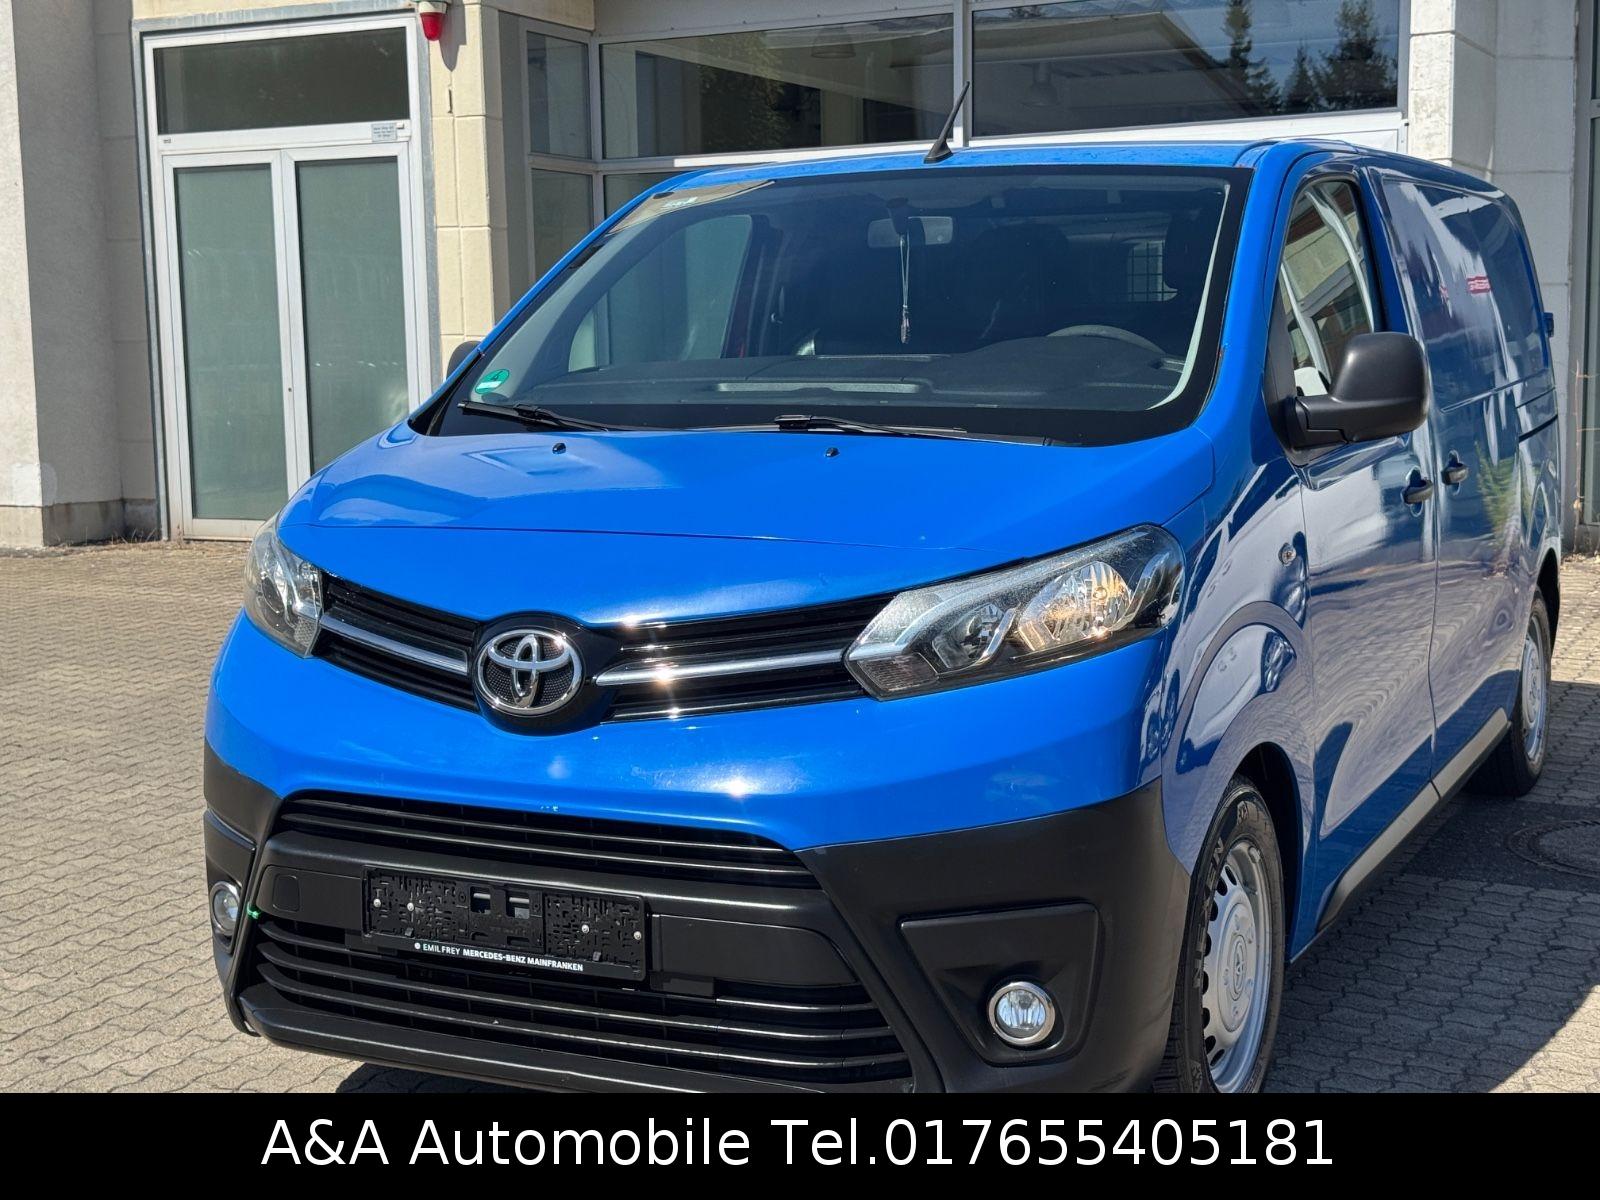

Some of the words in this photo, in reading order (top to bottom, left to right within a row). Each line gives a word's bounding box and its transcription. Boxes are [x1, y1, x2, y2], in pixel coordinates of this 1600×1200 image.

[422, 943, 441, 954] EMIL
[441, 945, 461, 956] FREY
[462, 948, 526, 964] MERCEDES-BENZ
[527, 956, 584, 972] MAINFRANKEN
